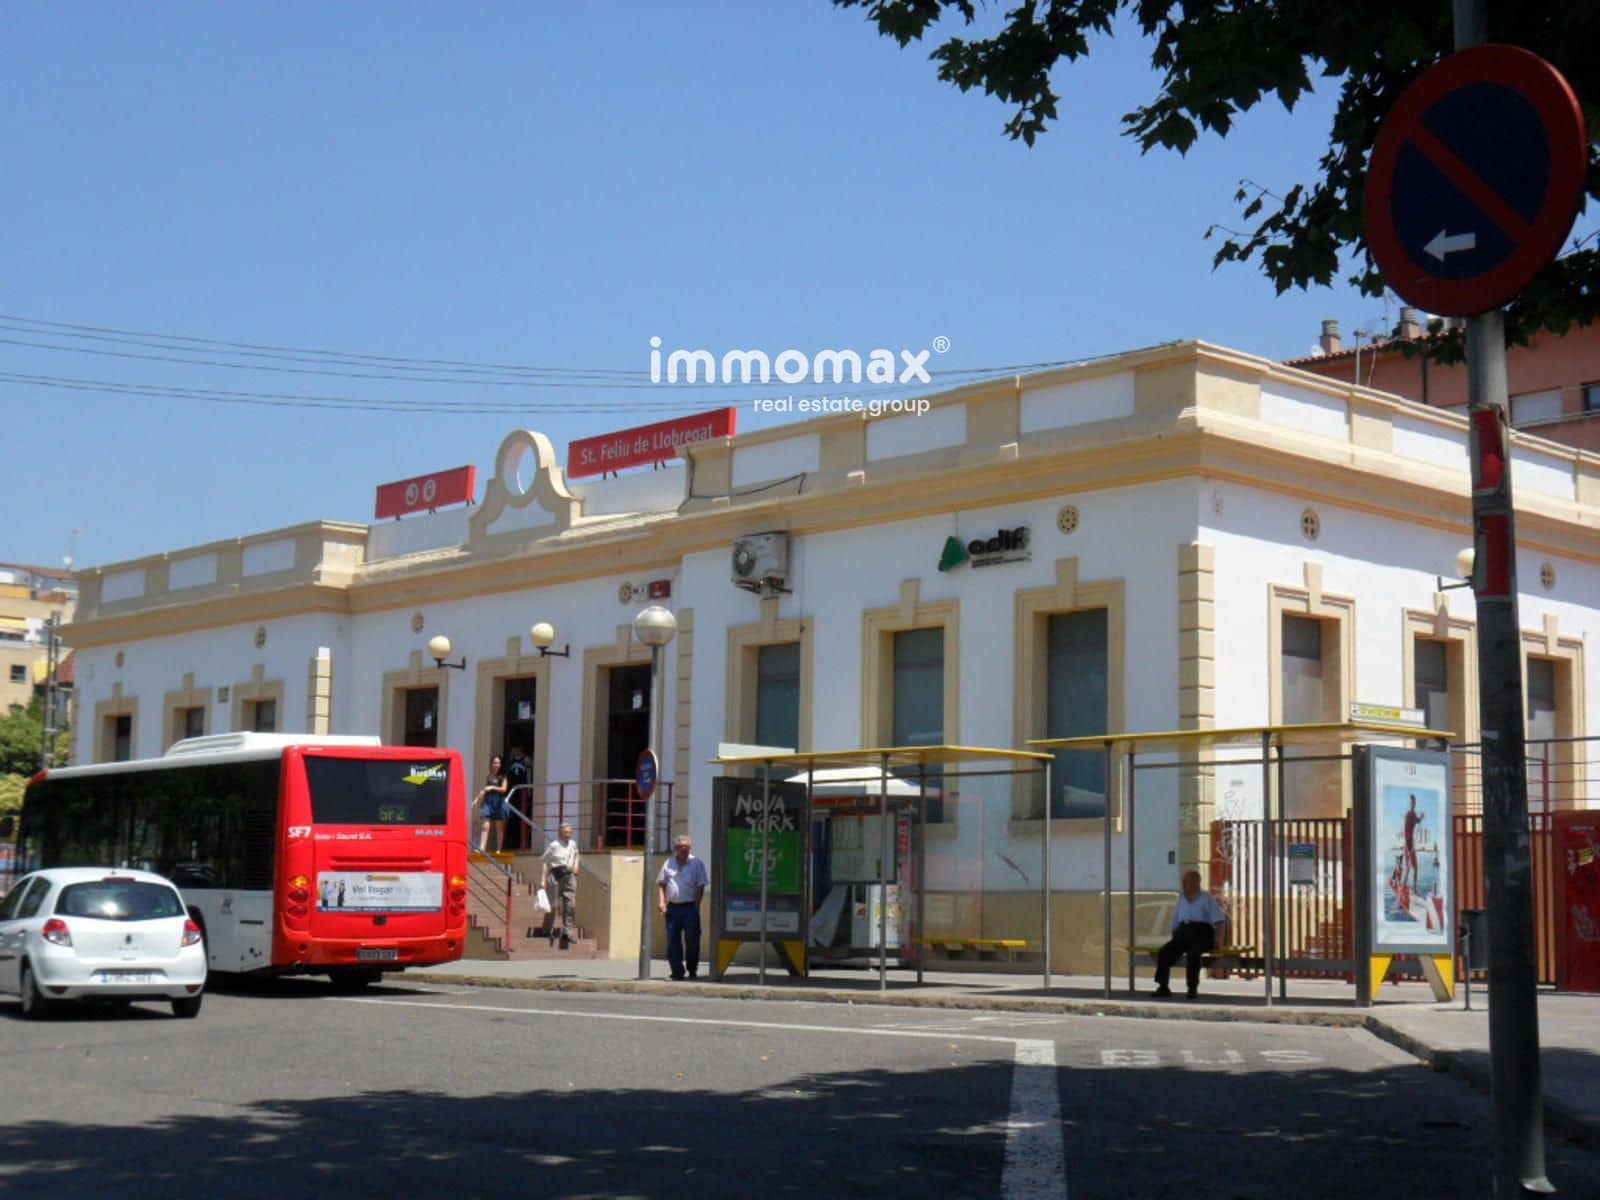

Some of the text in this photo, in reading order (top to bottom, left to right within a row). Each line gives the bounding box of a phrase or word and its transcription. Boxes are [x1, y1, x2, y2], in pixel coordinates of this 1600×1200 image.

[581, 423, 713, 465] St. Feliu de Llobregat
[287, 825, 312, 838] SF7
